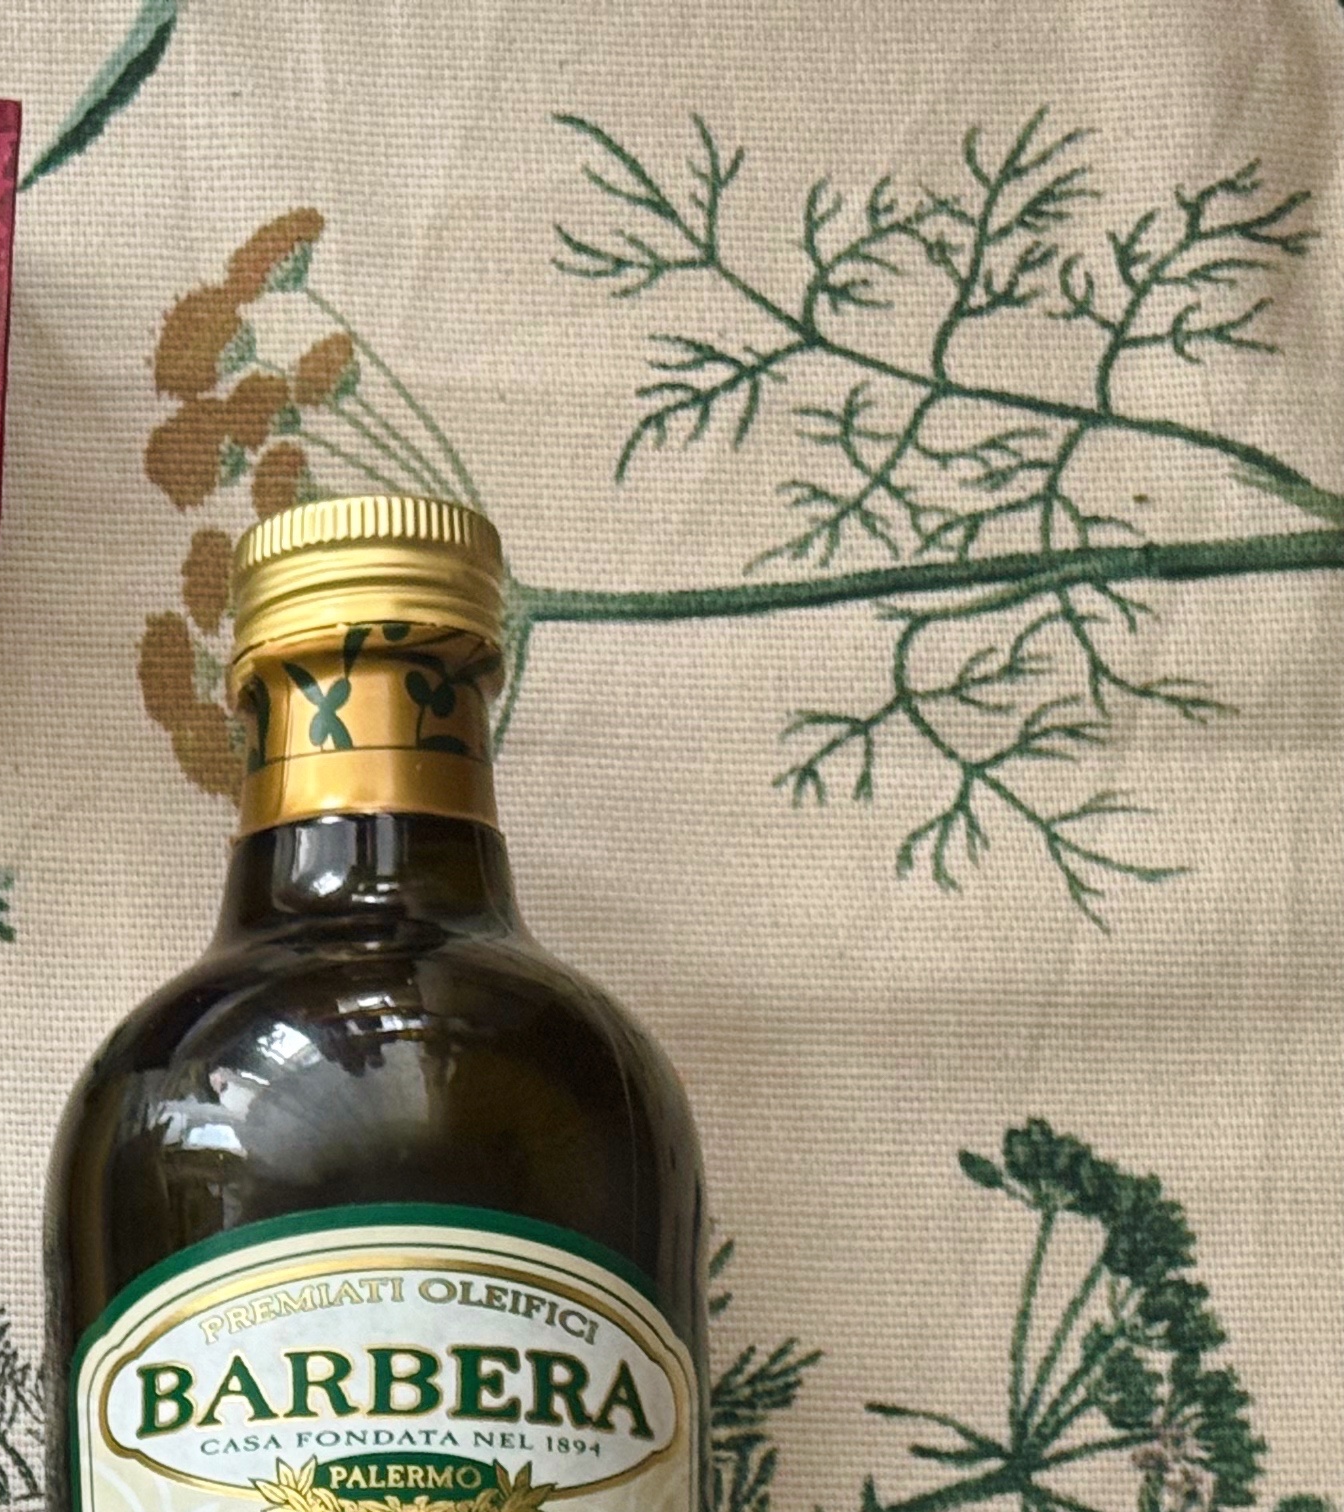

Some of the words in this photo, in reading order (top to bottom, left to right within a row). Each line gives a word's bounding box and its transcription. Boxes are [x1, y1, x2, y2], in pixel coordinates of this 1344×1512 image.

[201, 1277, 405, 1344] PREMIATI
[418, 1277, 599, 1345] OLEIFICI
[135, 1344, 656, 1441] BARBERA
[200, 1434, 282, 1457] CASA
[296, 1430, 458, 1448] FONDATA
[473, 1431, 534, 1452] NEL
[545, 1435, 603, 1457] 1894
[327, 1465, 483, 1491] PALERMO
